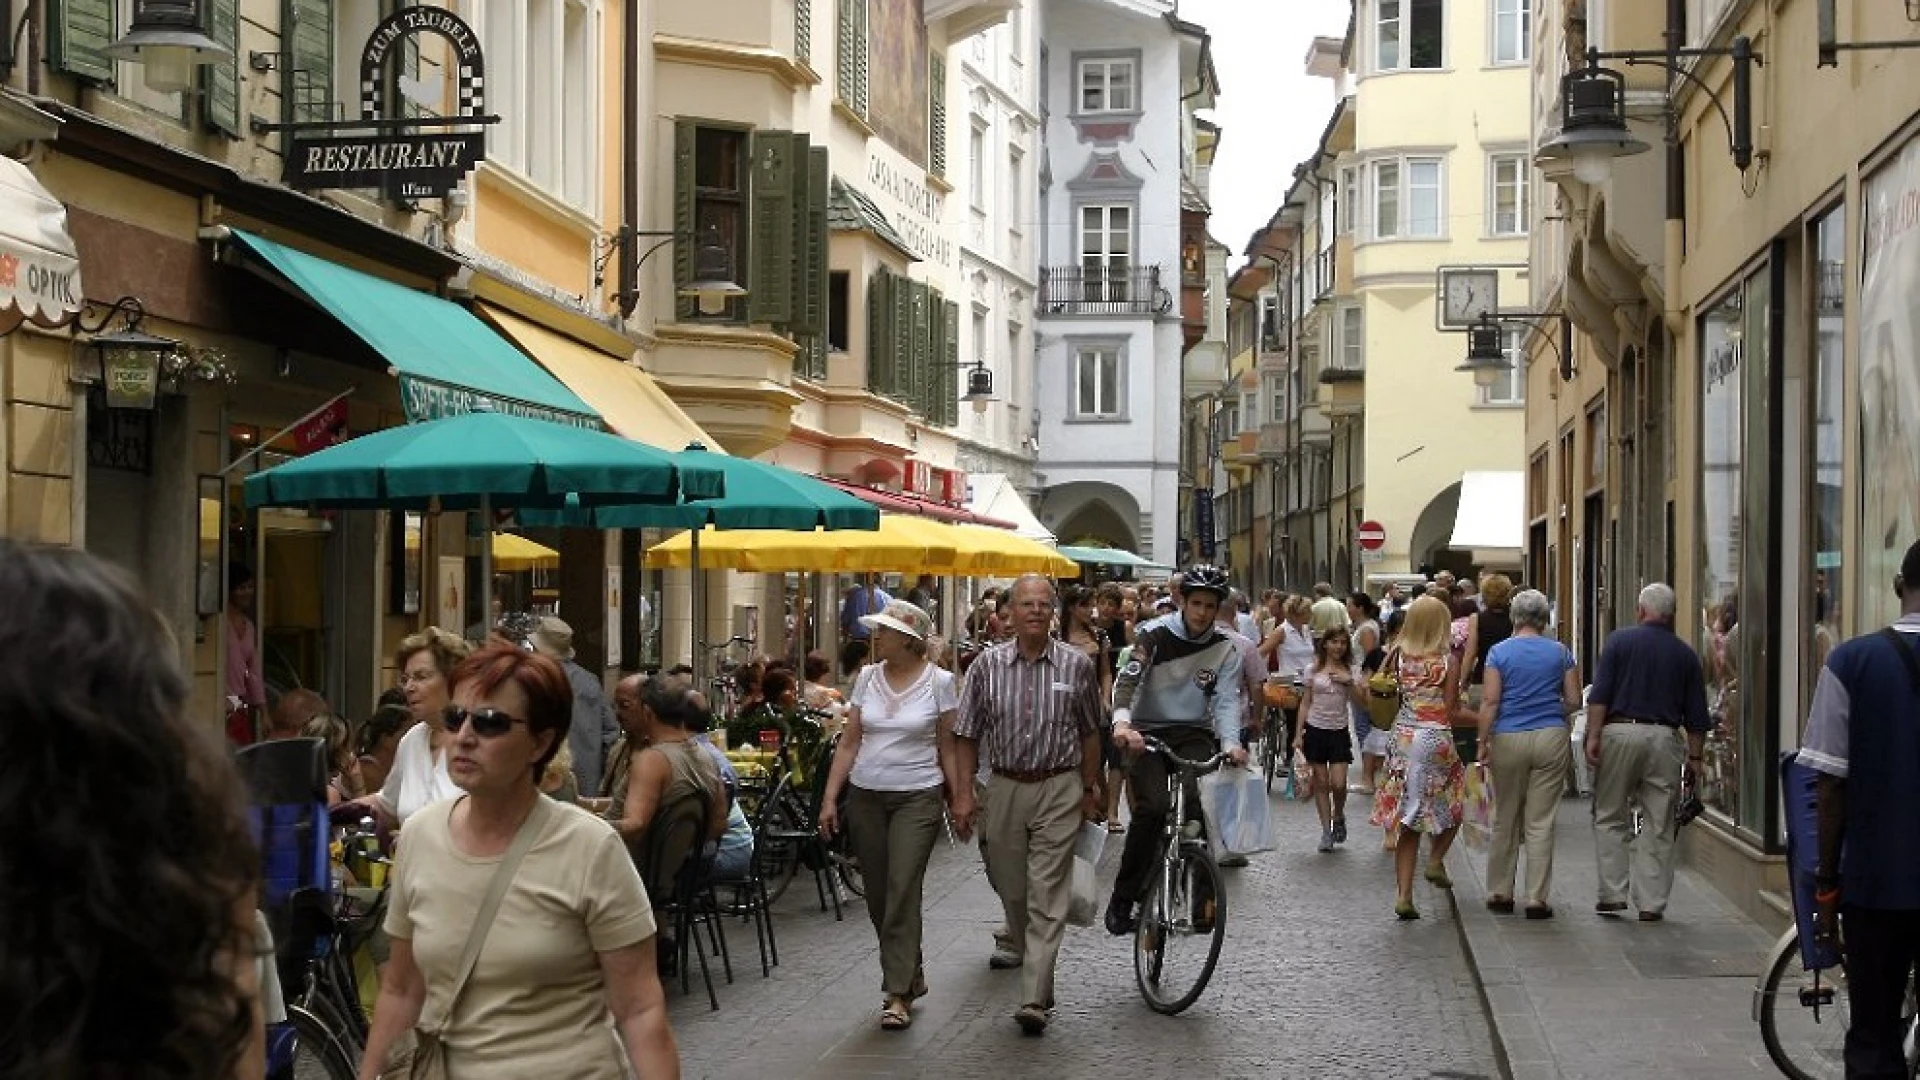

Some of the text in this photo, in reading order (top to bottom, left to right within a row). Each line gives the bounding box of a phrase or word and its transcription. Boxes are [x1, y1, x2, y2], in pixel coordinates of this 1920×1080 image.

[367, 21, 402, 63] ZUM
[303, 140, 466, 174] RESTAURANT
[27, 263, 77, 305] OPTIK
